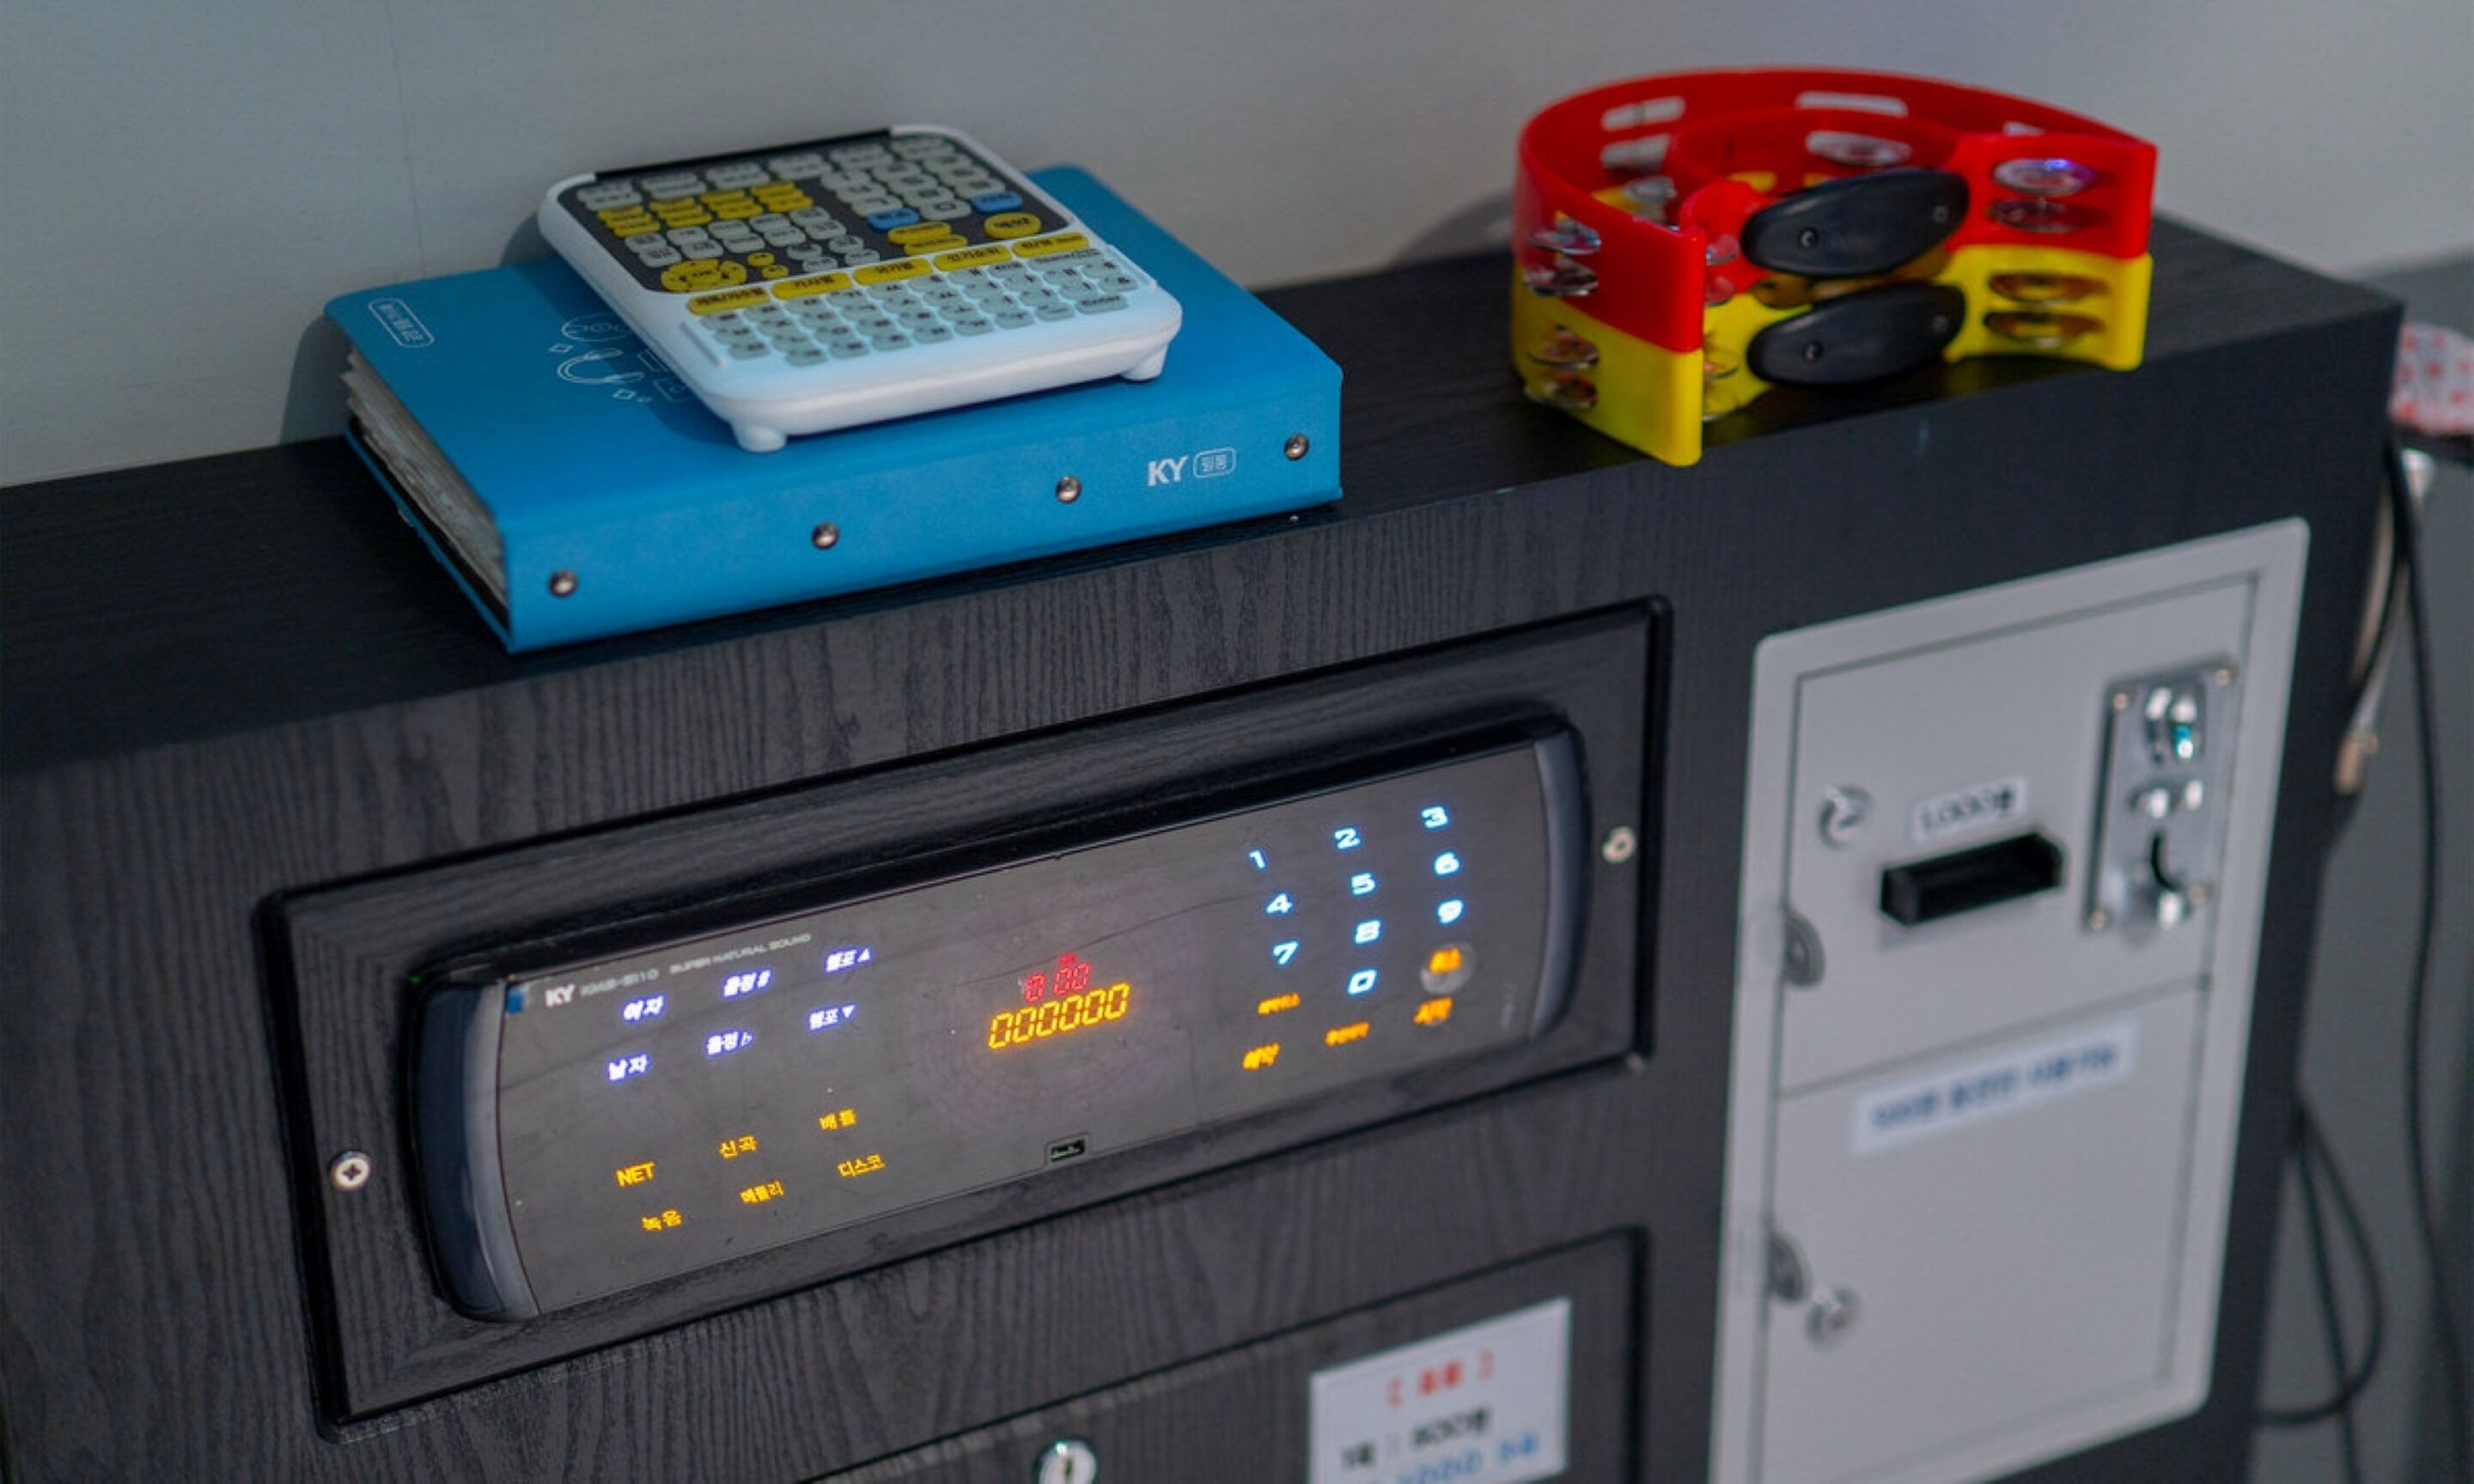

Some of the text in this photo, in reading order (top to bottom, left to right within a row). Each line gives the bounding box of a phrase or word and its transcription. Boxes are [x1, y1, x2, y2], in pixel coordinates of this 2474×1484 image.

[1147, 454, 1190, 487] KY
[1420, 805, 1449, 829] 3
[1333, 826, 1362, 850] 2
[1248, 849, 1267, 870] 1
[1433, 851, 1460, 876] 6
[1350, 871, 1376, 896] 5
[1265, 892, 1294, 915] 4
[1436, 898, 1465, 925] 9
[1354, 919, 1382, 945] 8
[1272, 940, 1300, 966] 7
[545, 983, 576, 1007] KY
[712, 946, 768, 964] NATURAL
[1348, 969, 1378, 996] 0
[623, 994, 664, 1021] 여자
[988, 981, 1131, 1049] 000000
[608, 1055, 649, 1081] 남자
[719, 1134, 758, 1159] 신곡
[615, 1161, 656, 1188] NET
[838, 1153, 886, 1177] 디스코
[740, 1180, 784, 1204] 메들리
